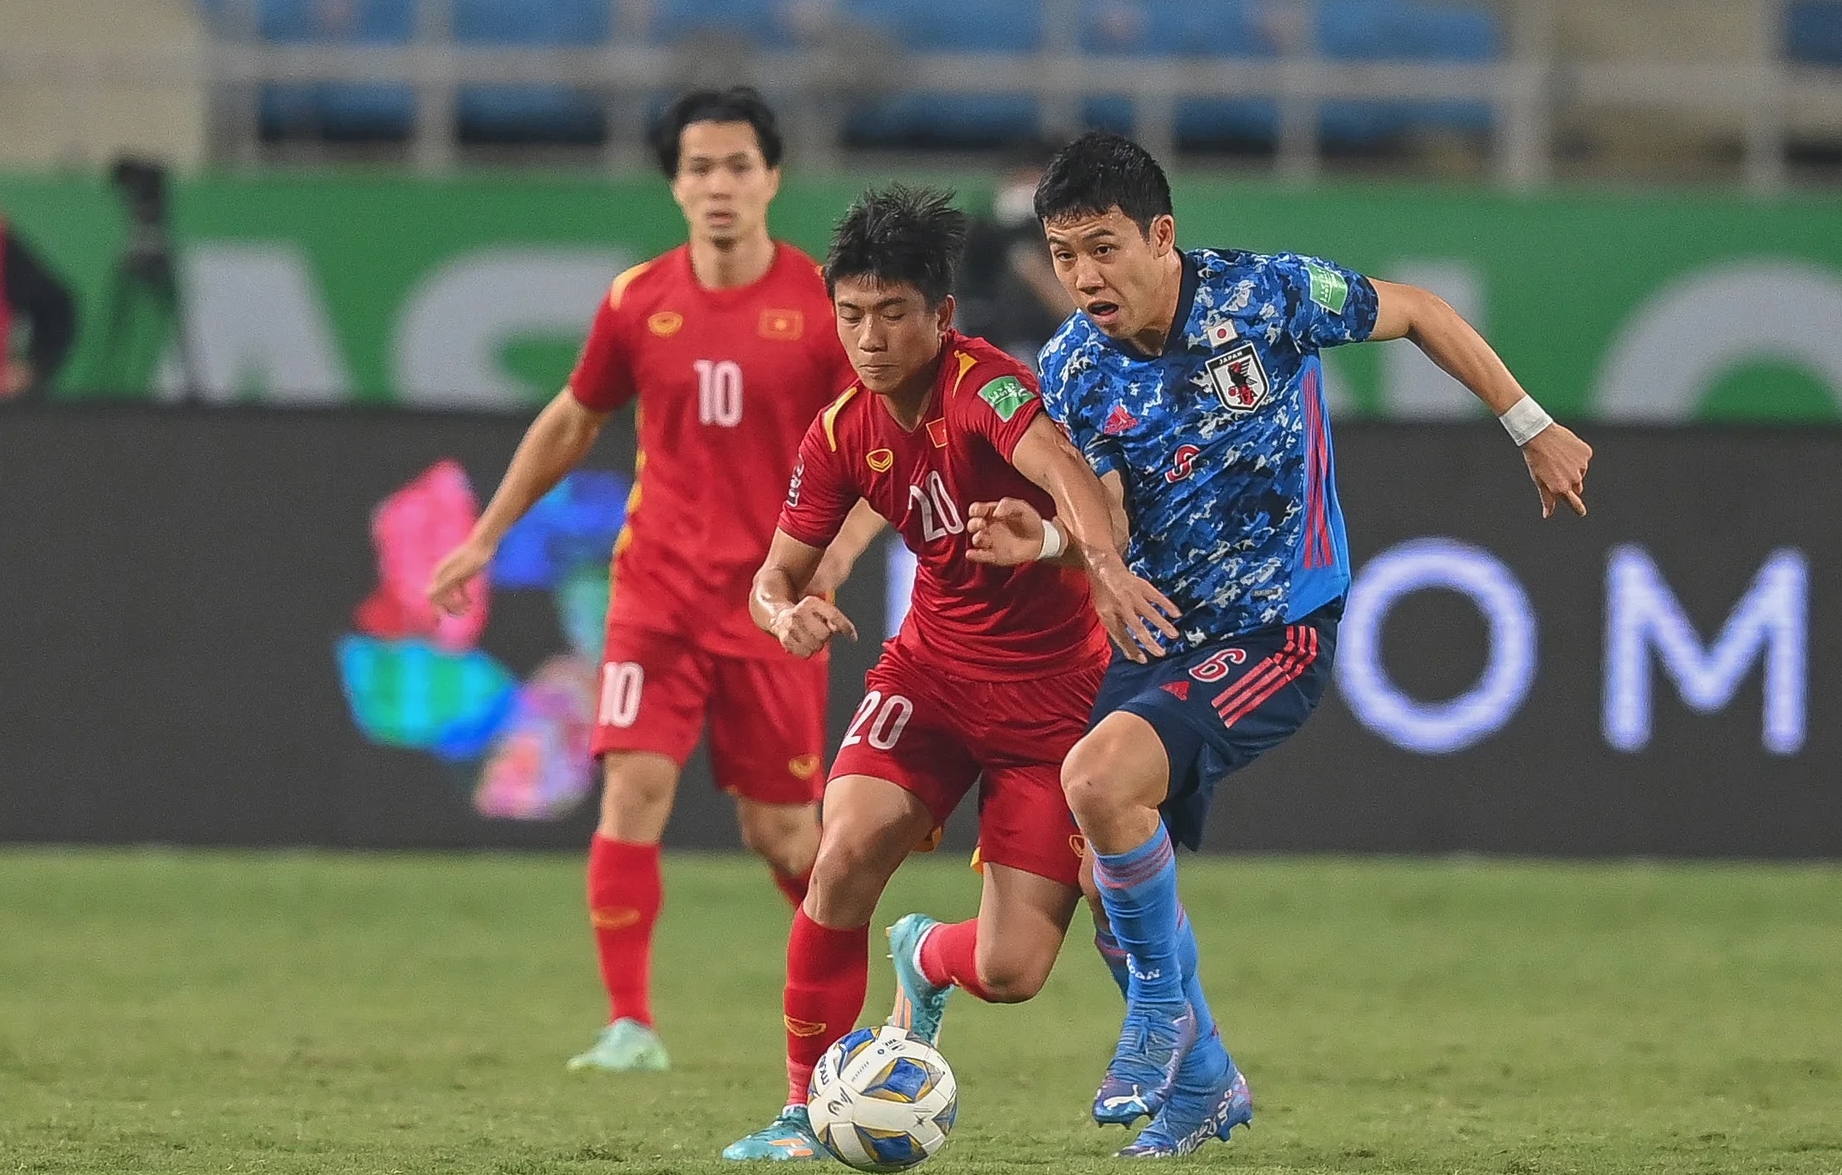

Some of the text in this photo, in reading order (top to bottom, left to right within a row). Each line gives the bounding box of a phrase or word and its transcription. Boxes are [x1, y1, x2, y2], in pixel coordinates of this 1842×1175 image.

[1218, 351, 1243, 365] JAPAN
[694, 358, 744, 428] 10
[908, 470, 965, 542] 20
[600, 661, 645, 728] 10
[1188, 648, 1247, 683] 6
[842, 690, 914, 750] 20
